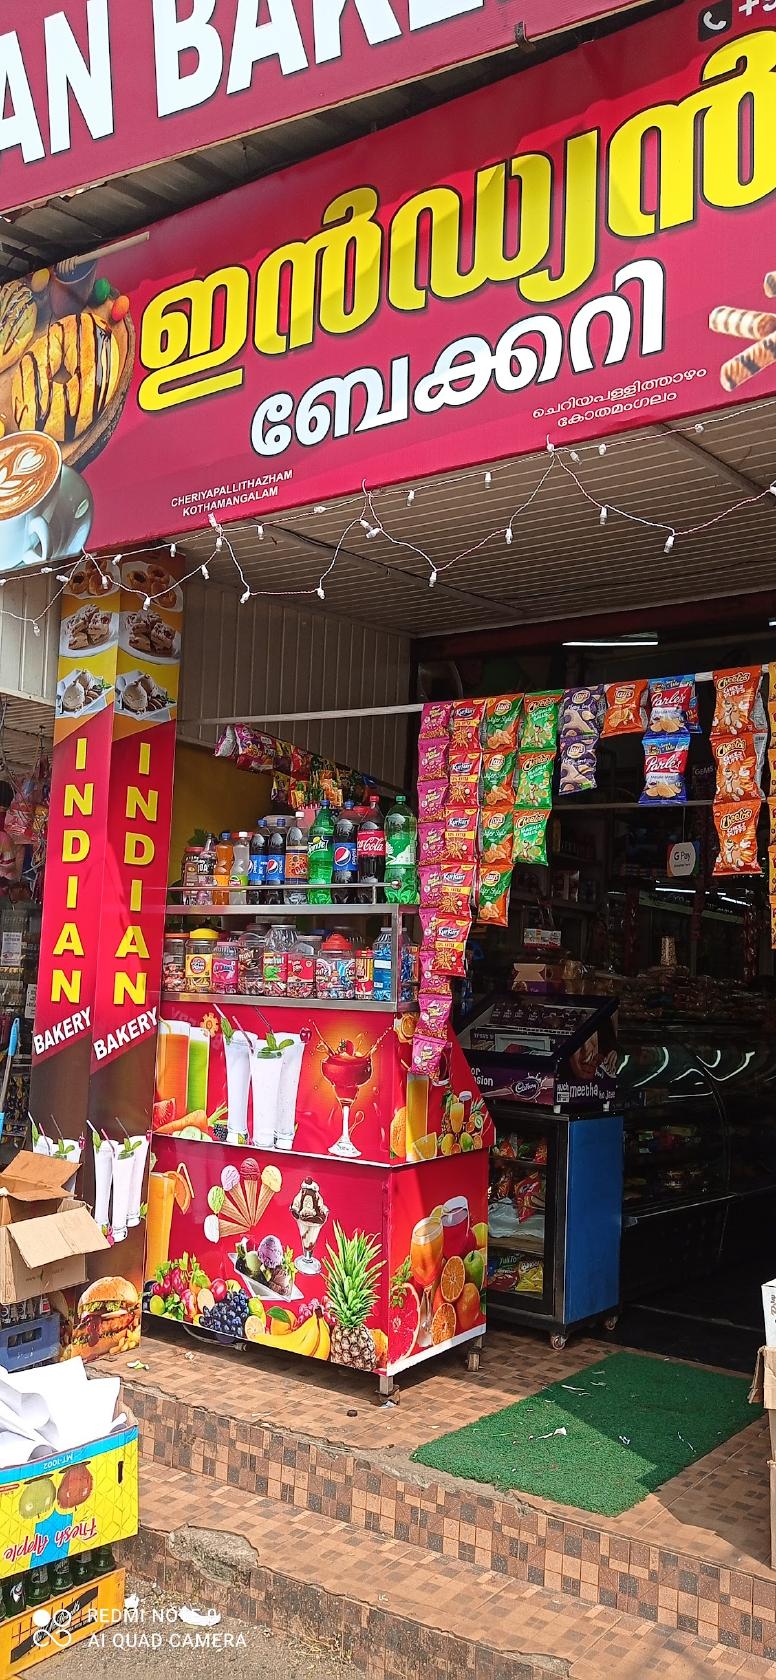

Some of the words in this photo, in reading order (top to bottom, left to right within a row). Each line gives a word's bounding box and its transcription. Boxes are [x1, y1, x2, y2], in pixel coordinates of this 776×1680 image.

[251, 258, 664, 457] ബേക്കറി
[532, 367, 707, 419] ചെറിയപള്ളിത്താഴം
[557, 391, 677, 428] കോതമംഗലം
[171, 469, 293, 507] CHERIYAPALLITHAZHAM
[182, 486, 278, 517] KOTHAMANGALAM
[51, 737, 94, 1003] INDIAN
[113, 742, 158, 1005] INDIAN
[33, 1006, 91, 1055] BAKERY
[93, 1006, 157, 1060] BAKERY
[43, 1452, 74, 1470] MT-1002
[4, 1533, 49, 1562] Apple
[56, 1517, 98, 1547] Fresh
